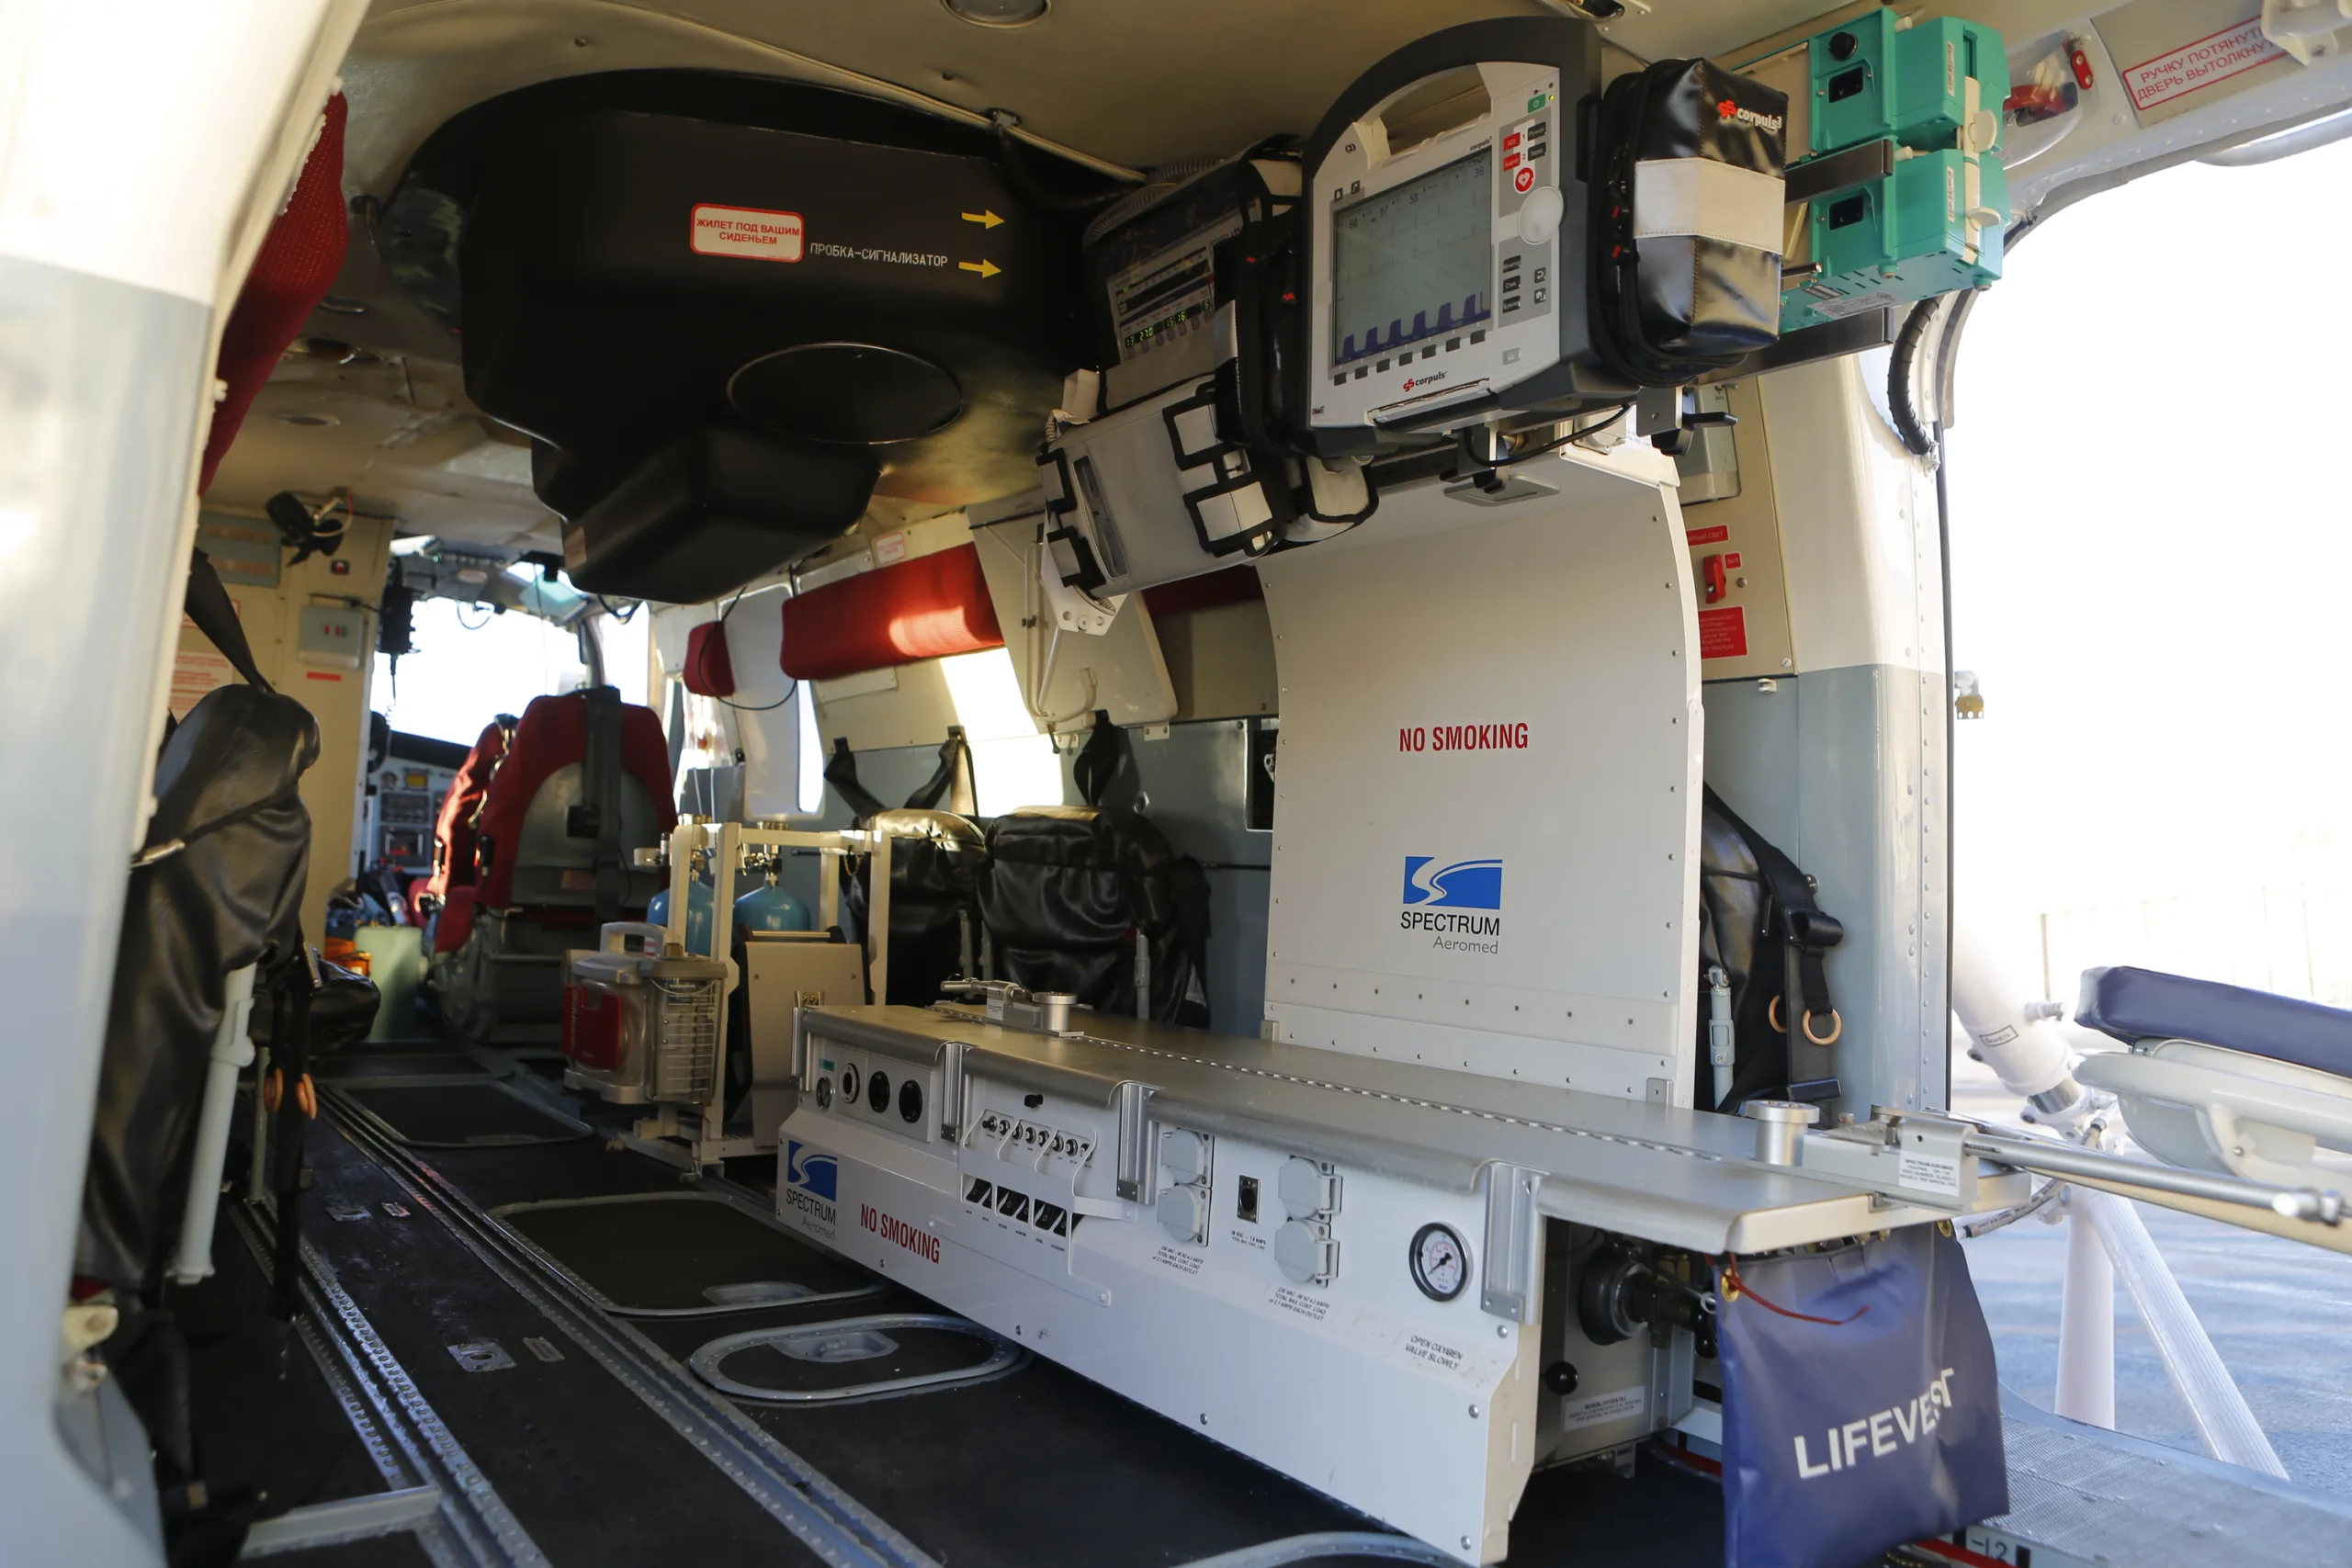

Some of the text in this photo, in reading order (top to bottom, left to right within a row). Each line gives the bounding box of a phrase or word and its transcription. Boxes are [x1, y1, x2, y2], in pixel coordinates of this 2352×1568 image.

[2141, 57, 2184, 83] РУЧКУ
[2137, 76, 2184, 101] ДВЕРЬ
[1345, 143, 1356, 153] (2)
[1474, 166, 1485, 178] 36
[1379, 205, 1388, 217] 97
[696, 219, 800, 236] ЖИЛЕТ ПОД ВАШИМ
[719, 231, 777, 244] СИДЕНЬЕМ
[810, 243, 948, 267] ПРОБКА-СИГНАЛИЗАТОР
[1415, 371, 1445, 386] corpuls
[1399, 722, 1529, 751] NO SMOKING
[1400, 910, 1500, 936] SPECTRUM
[1432, 935, 1498, 954] Aeromed
[786, 1188, 836, 1225] SPECTRUM
[802, 1214, 835, 1241] Aeromed
[860, 1203, 940, 1265] NO SMOKING
[1405, 1343, 1460, 1371] VALVE SLOWLY
[1410, 1334, 1464, 1360] OPEN OXYGEN
